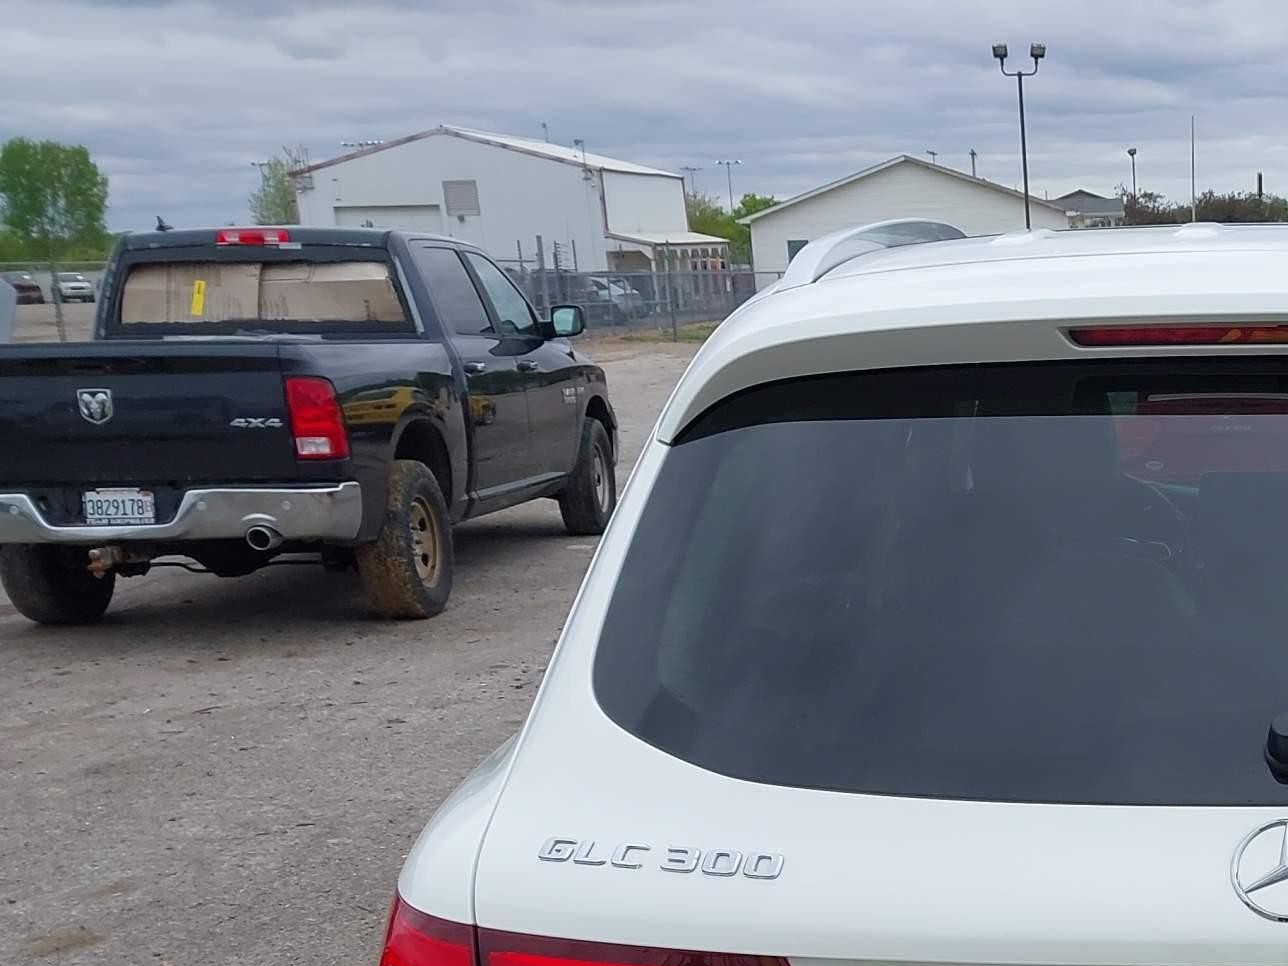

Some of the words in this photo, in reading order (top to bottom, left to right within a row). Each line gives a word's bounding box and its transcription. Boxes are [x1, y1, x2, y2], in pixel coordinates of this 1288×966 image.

[87, 499, 144, 515] 3829178
[537, 837, 651, 870] GLC
[659, 845, 785, 880] 300
